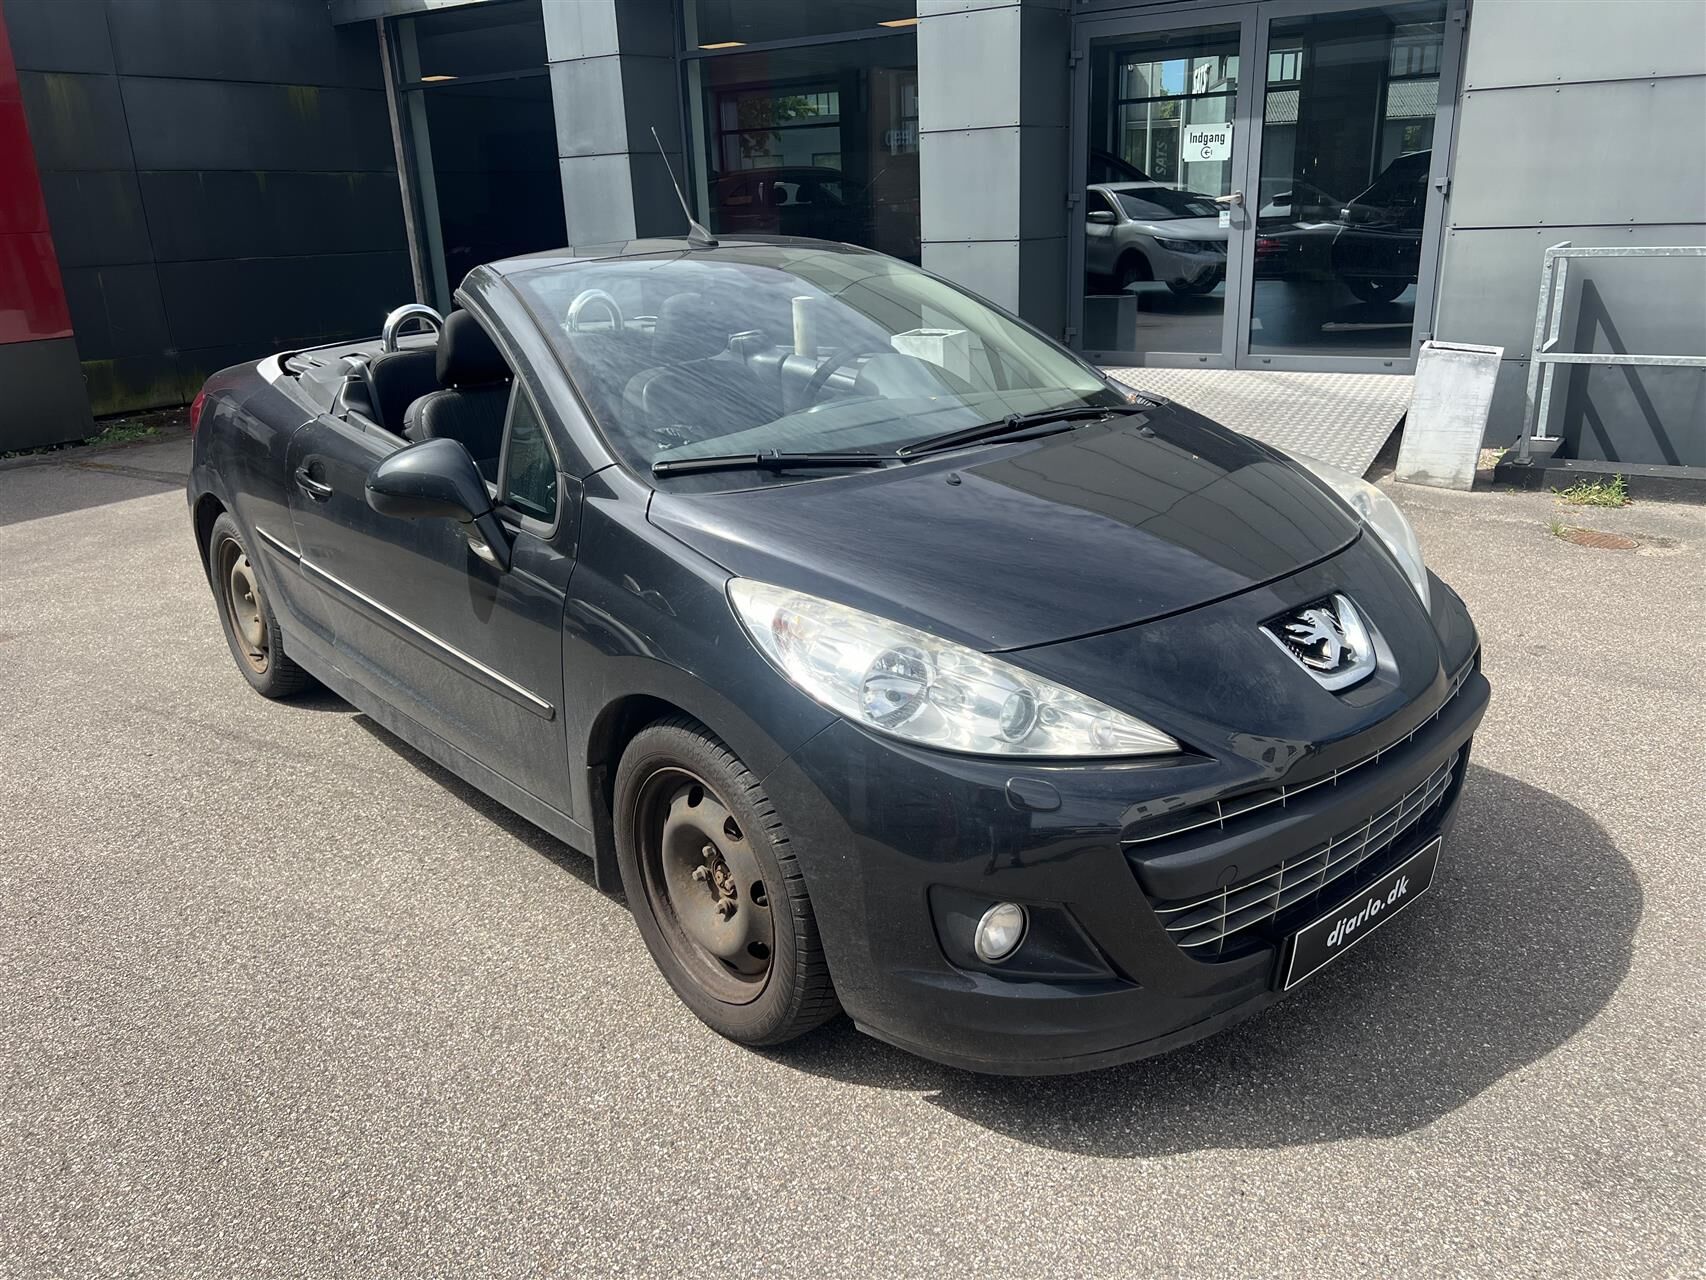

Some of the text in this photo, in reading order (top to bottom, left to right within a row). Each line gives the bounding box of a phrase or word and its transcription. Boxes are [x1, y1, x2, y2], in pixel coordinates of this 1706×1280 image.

[1190, 132, 1225, 145] Indgang
[1155, 141, 1167, 175] SATS
[1326, 875, 1410, 946] djarlo.dk
